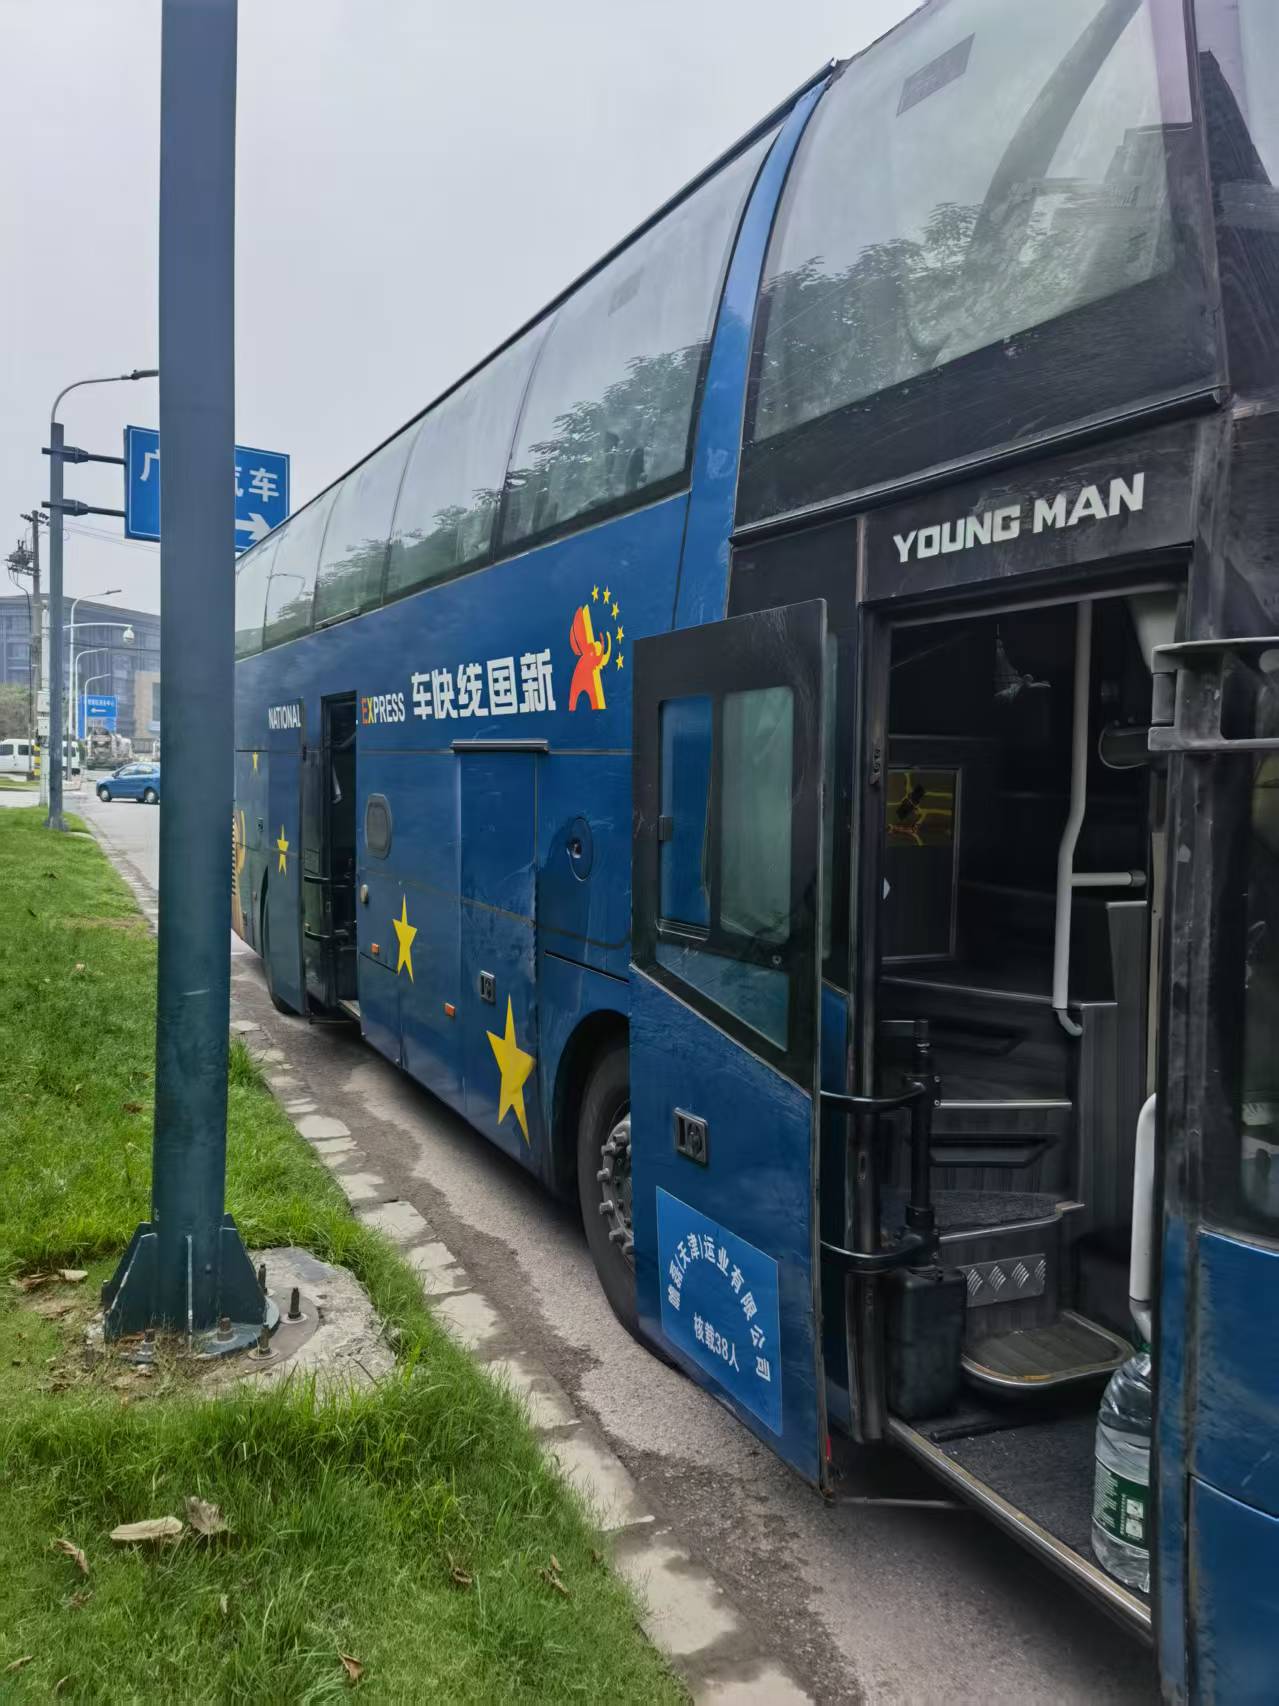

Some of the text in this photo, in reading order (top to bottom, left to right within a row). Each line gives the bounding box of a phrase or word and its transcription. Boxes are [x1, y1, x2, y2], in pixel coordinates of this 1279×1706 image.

[893, 471, 1145, 563] YOUNG MAN
[268, 693, 405, 729] NATIONAL EXPRESS
